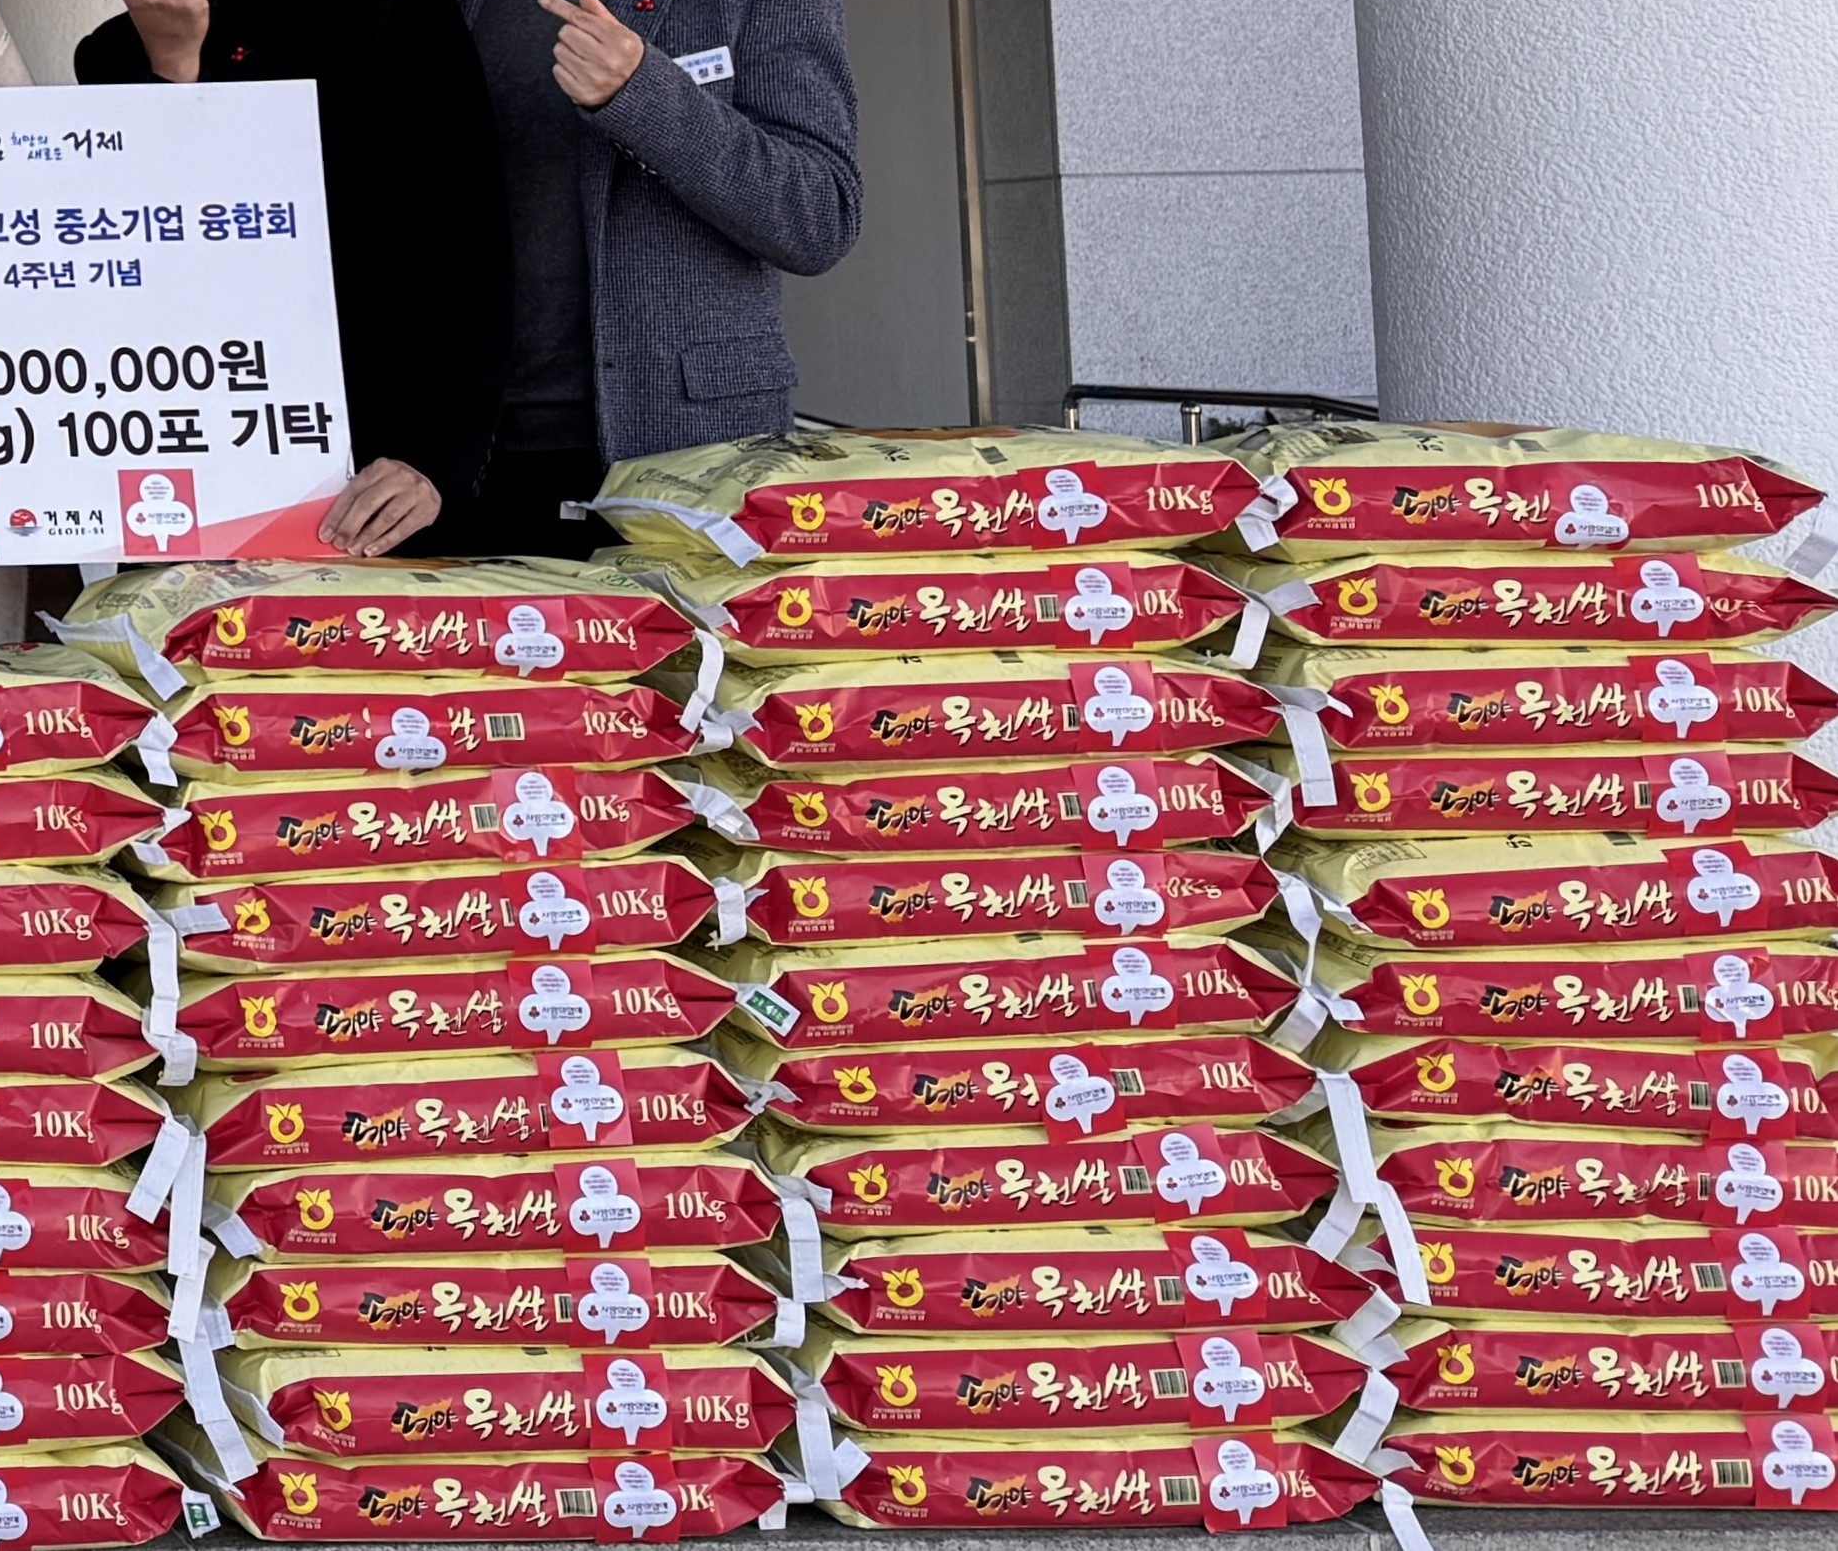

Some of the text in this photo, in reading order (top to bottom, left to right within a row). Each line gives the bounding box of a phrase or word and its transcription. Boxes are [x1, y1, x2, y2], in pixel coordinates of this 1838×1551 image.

[63, 129, 123, 159] 거제
[54, 204, 185, 246] 중소기업
[198, 201, 298, 241] 융합회
[3, 261, 77, 291] 4주년
[88, 258, 143, 289] 기념
[58, 407, 209, 459] 100포
[231, 401, 333, 455] 기탁
[1148, 485, 1213, 514] 10Kg
[43, 509, 104, 527] 거제시
[24, 707, 92, 737] 10Kg
[1159, 783, 1225, 815] 10Kg
[598, 888, 667, 920] 10Kg
[611, 986, 683, 1018] 10Kg
[638, 1093, 706, 1125] 10Kg
[54, 1381, 124, 1415] 10Kg
